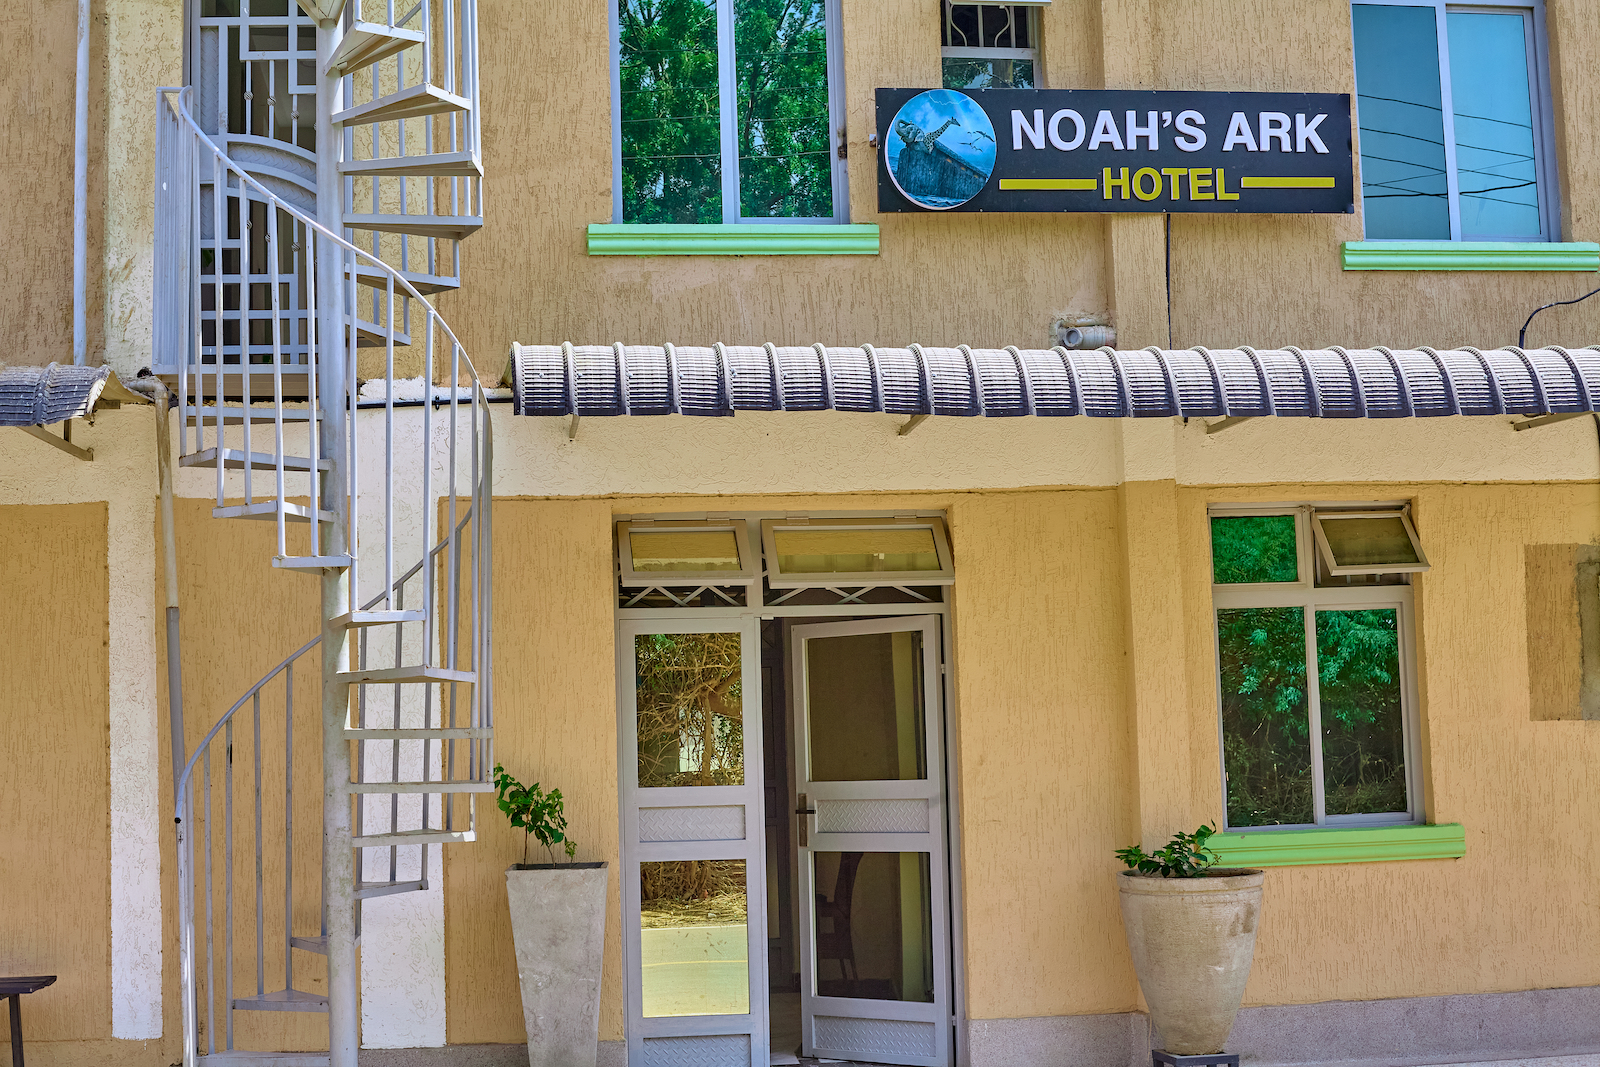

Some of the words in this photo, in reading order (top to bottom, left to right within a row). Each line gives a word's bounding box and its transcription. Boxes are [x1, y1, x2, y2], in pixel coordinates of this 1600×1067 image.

[1010, 108, 1208, 153] NOAH'S
[1222, 111, 1331, 154] ARK
[1102, 166, 1240, 202] HOTEL
